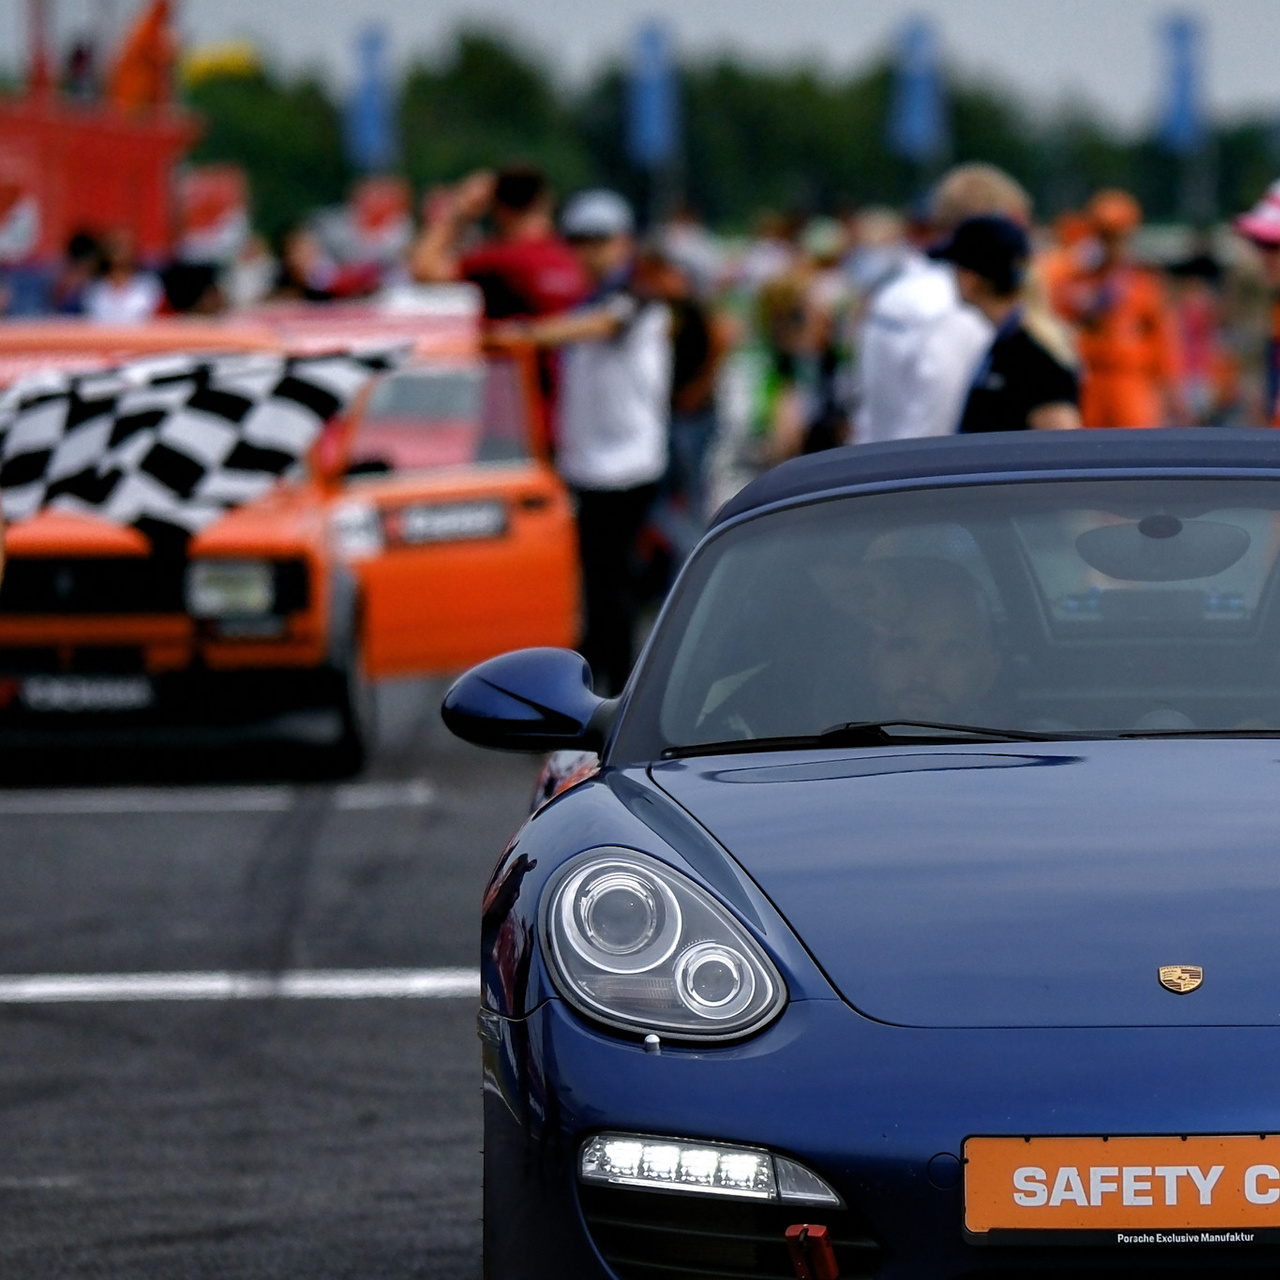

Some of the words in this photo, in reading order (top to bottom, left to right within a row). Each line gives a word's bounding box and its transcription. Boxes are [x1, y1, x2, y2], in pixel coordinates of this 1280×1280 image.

[1012, 1165, 1225, 1206] SAFETY
[1156, 1233, 1200, 1243] Exclusive
[1200, 1231, 1255, 1243] Manufaktur
